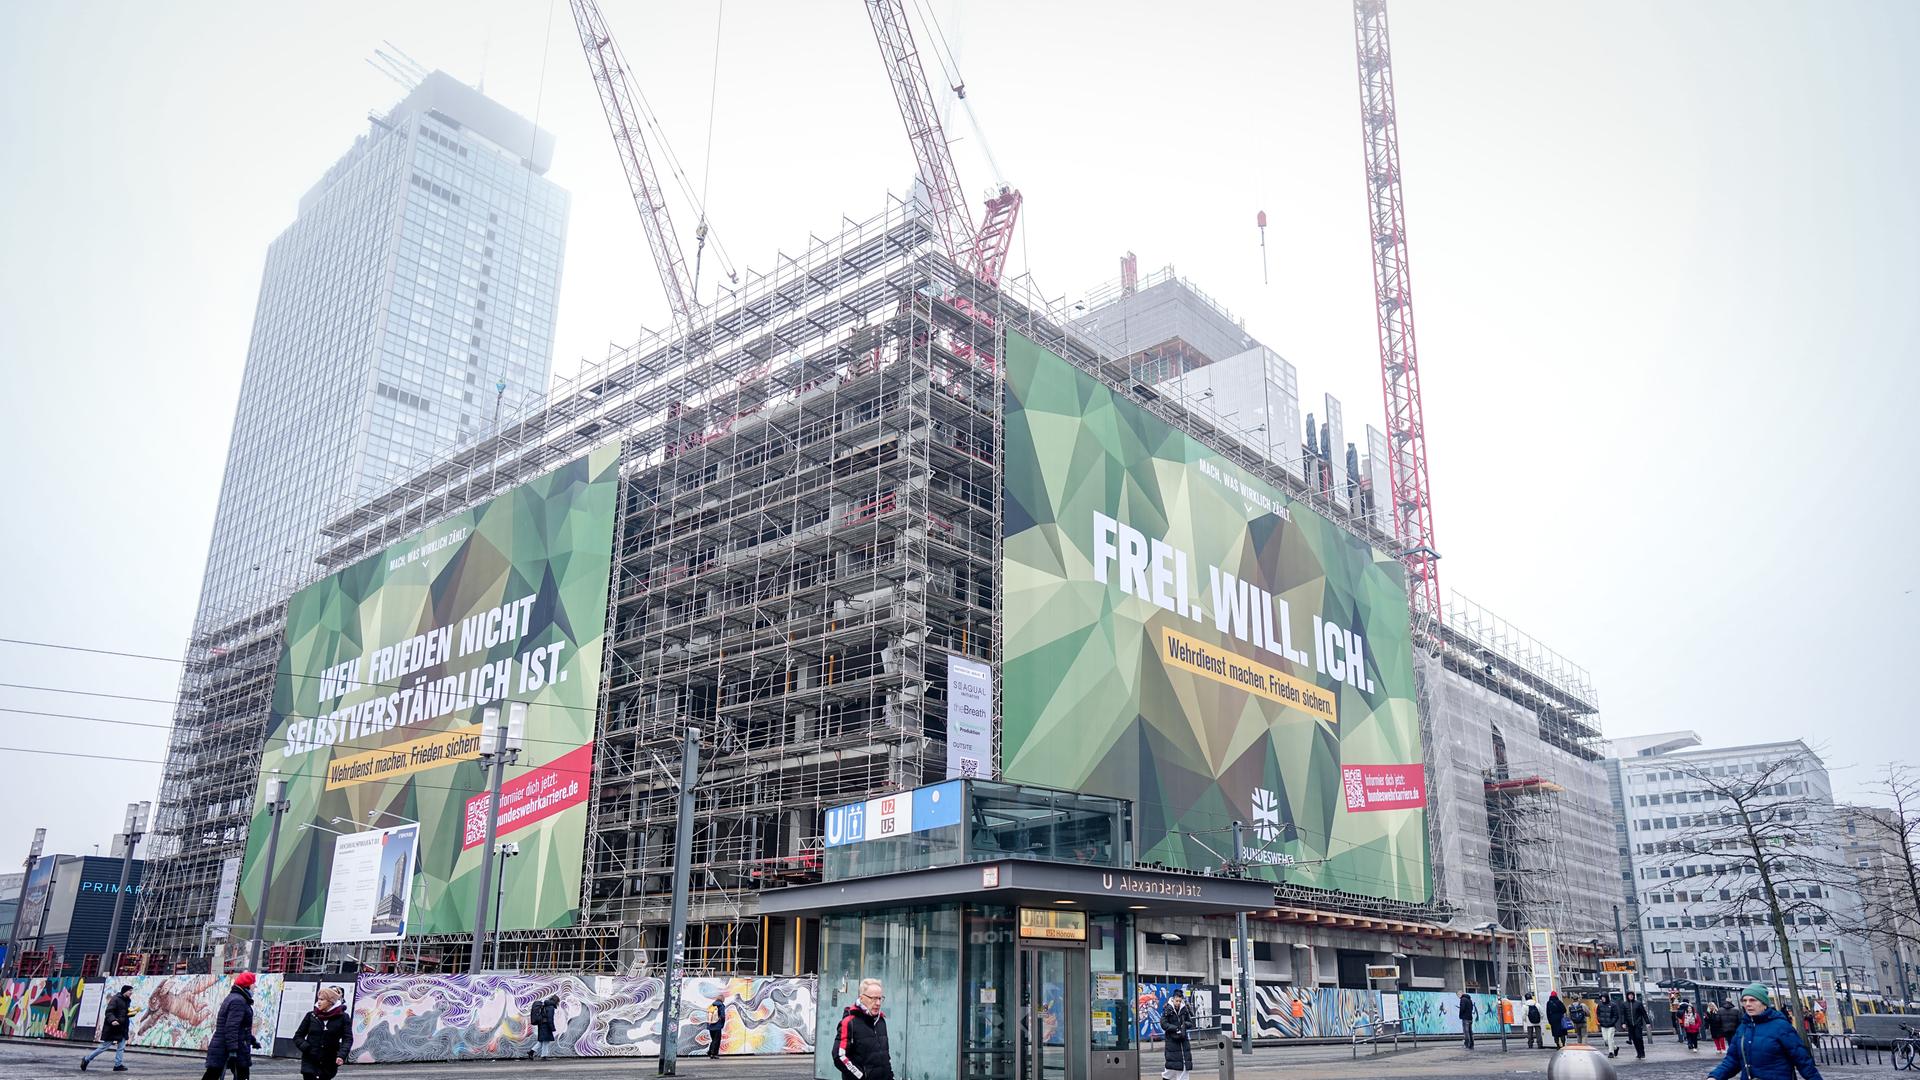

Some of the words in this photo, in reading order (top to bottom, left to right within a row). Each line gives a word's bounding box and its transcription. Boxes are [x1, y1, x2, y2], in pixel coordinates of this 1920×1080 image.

[1223, 472, 1239, 492] WAS
[1240, 481, 1271, 511] WIRKLICH
[1272, 501, 1292, 523] ZÄHLT.
[408, 548, 419, 563] WAS
[420, 536, 448, 557] WIRKLICH
[1093, 510, 1202, 623] FREI.
[1209, 564, 1308, 667] WILL.
[1313, 614, 1375, 695] ICH.
[319, 656, 362, 703] WEIL
[368, 624, 454, 686] FRIEDEN
[459, 594, 537, 657] NICHT
[1168, 635, 1226, 677] Wehrdienst
[1229, 664, 1267, 694] machen,
[1269, 674, 1300, 703] Frieden
[1302, 689, 1333, 715] sichern.
[283, 656, 513, 758] SELBSTVERSTÄNDLICH
[519, 640, 567, 694] IST.
[331, 759, 374, 784] Wehrdienst
[375, 752, 407, 776] machen,
[410, 744, 443, 766] Frieden
[525, 778, 540, 797] dich
[540, 772, 558, 793] jetzt:
[882, 801, 894, 814] U2
[882, 819, 894, 832] U5
[828, 810, 843, 844] U
[1103, 874, 1113, 889] U
[1119, 875, 1202, 898] Alexanderplatz
